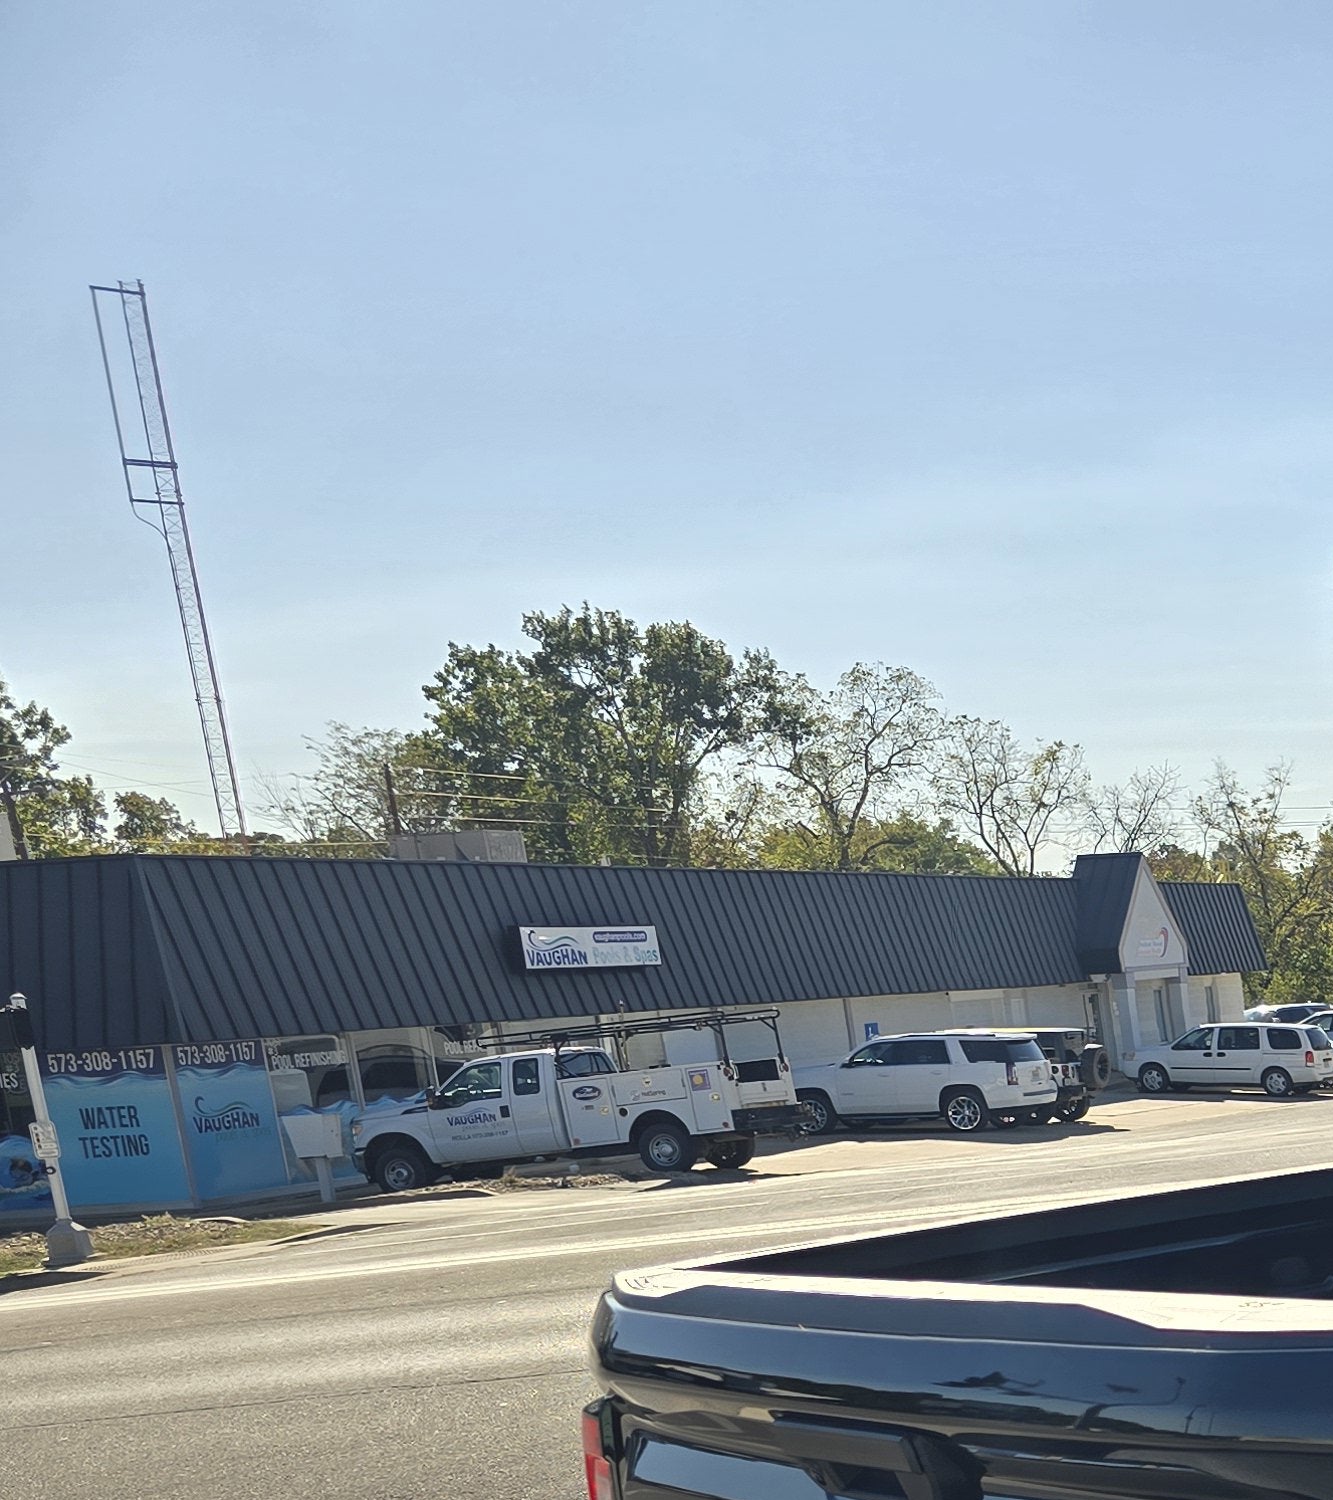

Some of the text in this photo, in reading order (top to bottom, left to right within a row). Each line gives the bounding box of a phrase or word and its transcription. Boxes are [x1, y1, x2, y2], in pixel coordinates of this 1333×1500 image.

[526, 949, 589, 966] VAUGHAN
[592, 947, 622, 964] Pools
[633, 946, 659, 965] Spas
[47, 1049, 155, 1073] 573-308-1157
[177, 1042, 256, 1066] 573-308-1157
[271, 1050, 347, 1070] POOL REFINISHING
[79, 1105, 141, 1130] WATER
[192, 1112, 260, 1134] VAUGHAN
[447, 1112, 497, 1126] VAUGHAN
[78, 1134, 149, 1159] TESTING
